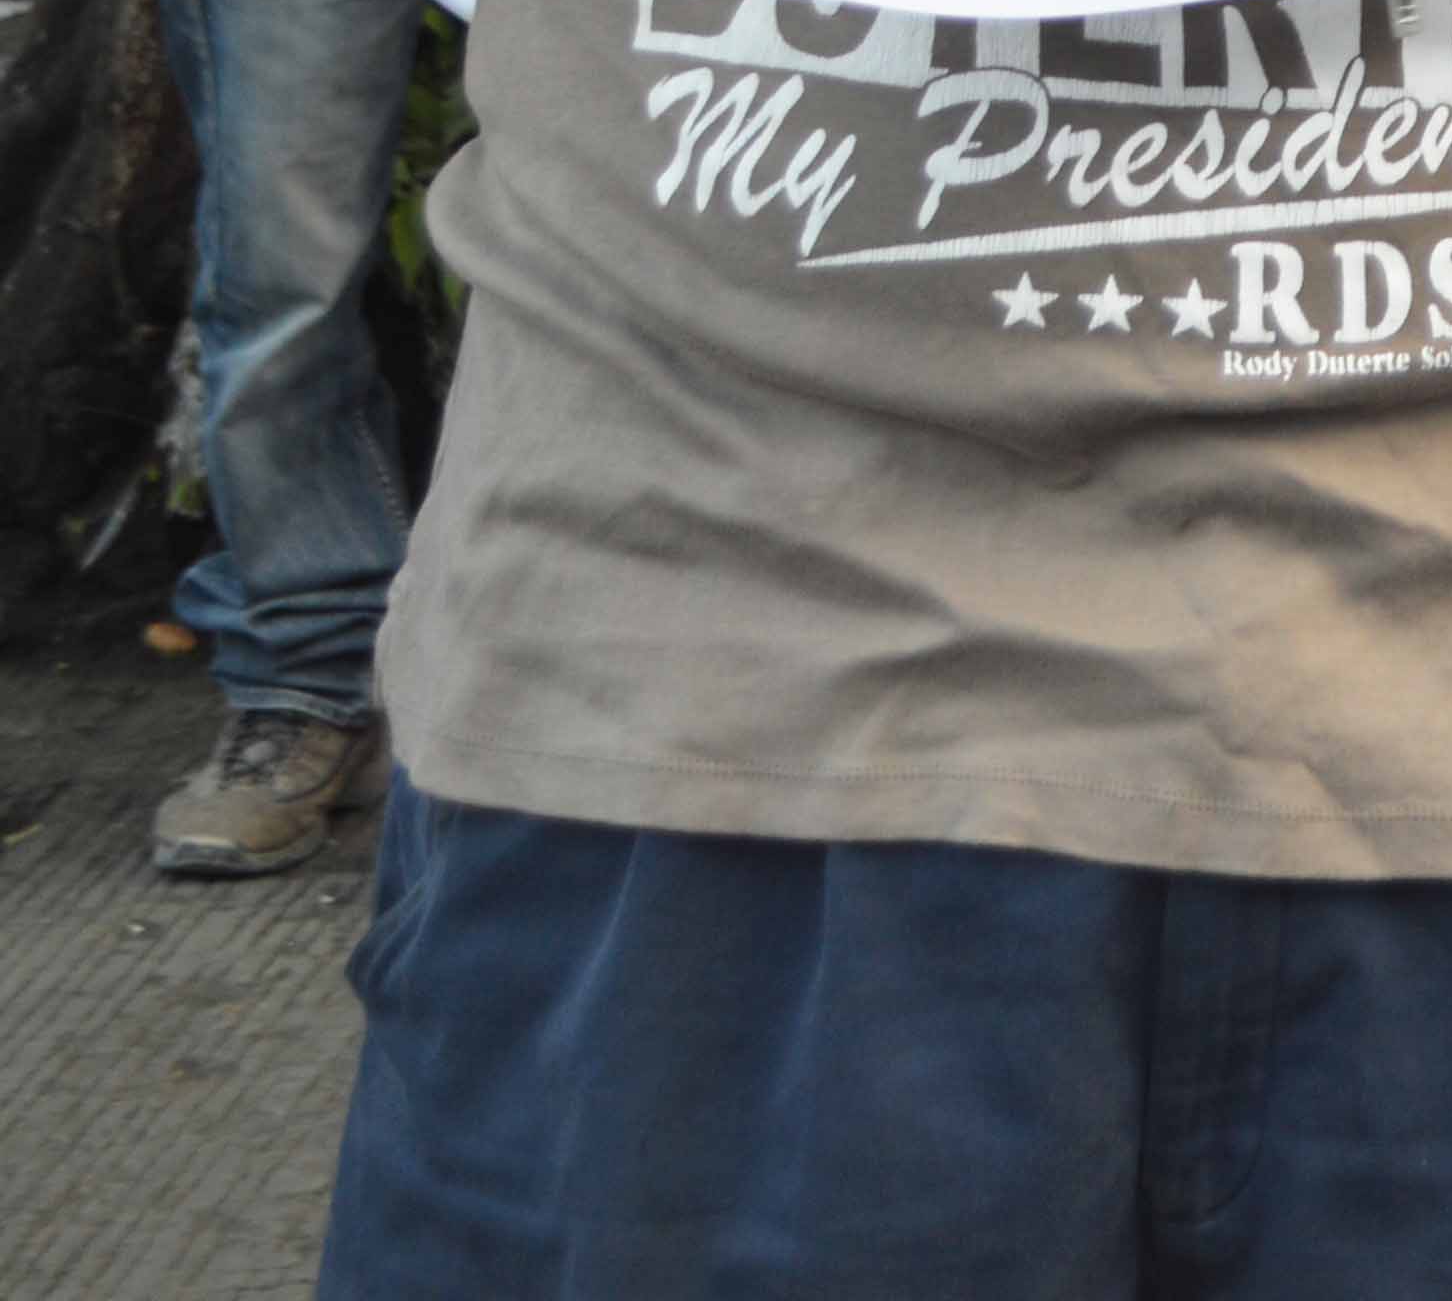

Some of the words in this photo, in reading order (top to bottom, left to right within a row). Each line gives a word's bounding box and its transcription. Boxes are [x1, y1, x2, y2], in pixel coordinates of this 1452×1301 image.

[647, 69, 855, 259] My
[1223, 349, 1298, 382] Rody
[1306, 348, 1411, 377] Duterte
